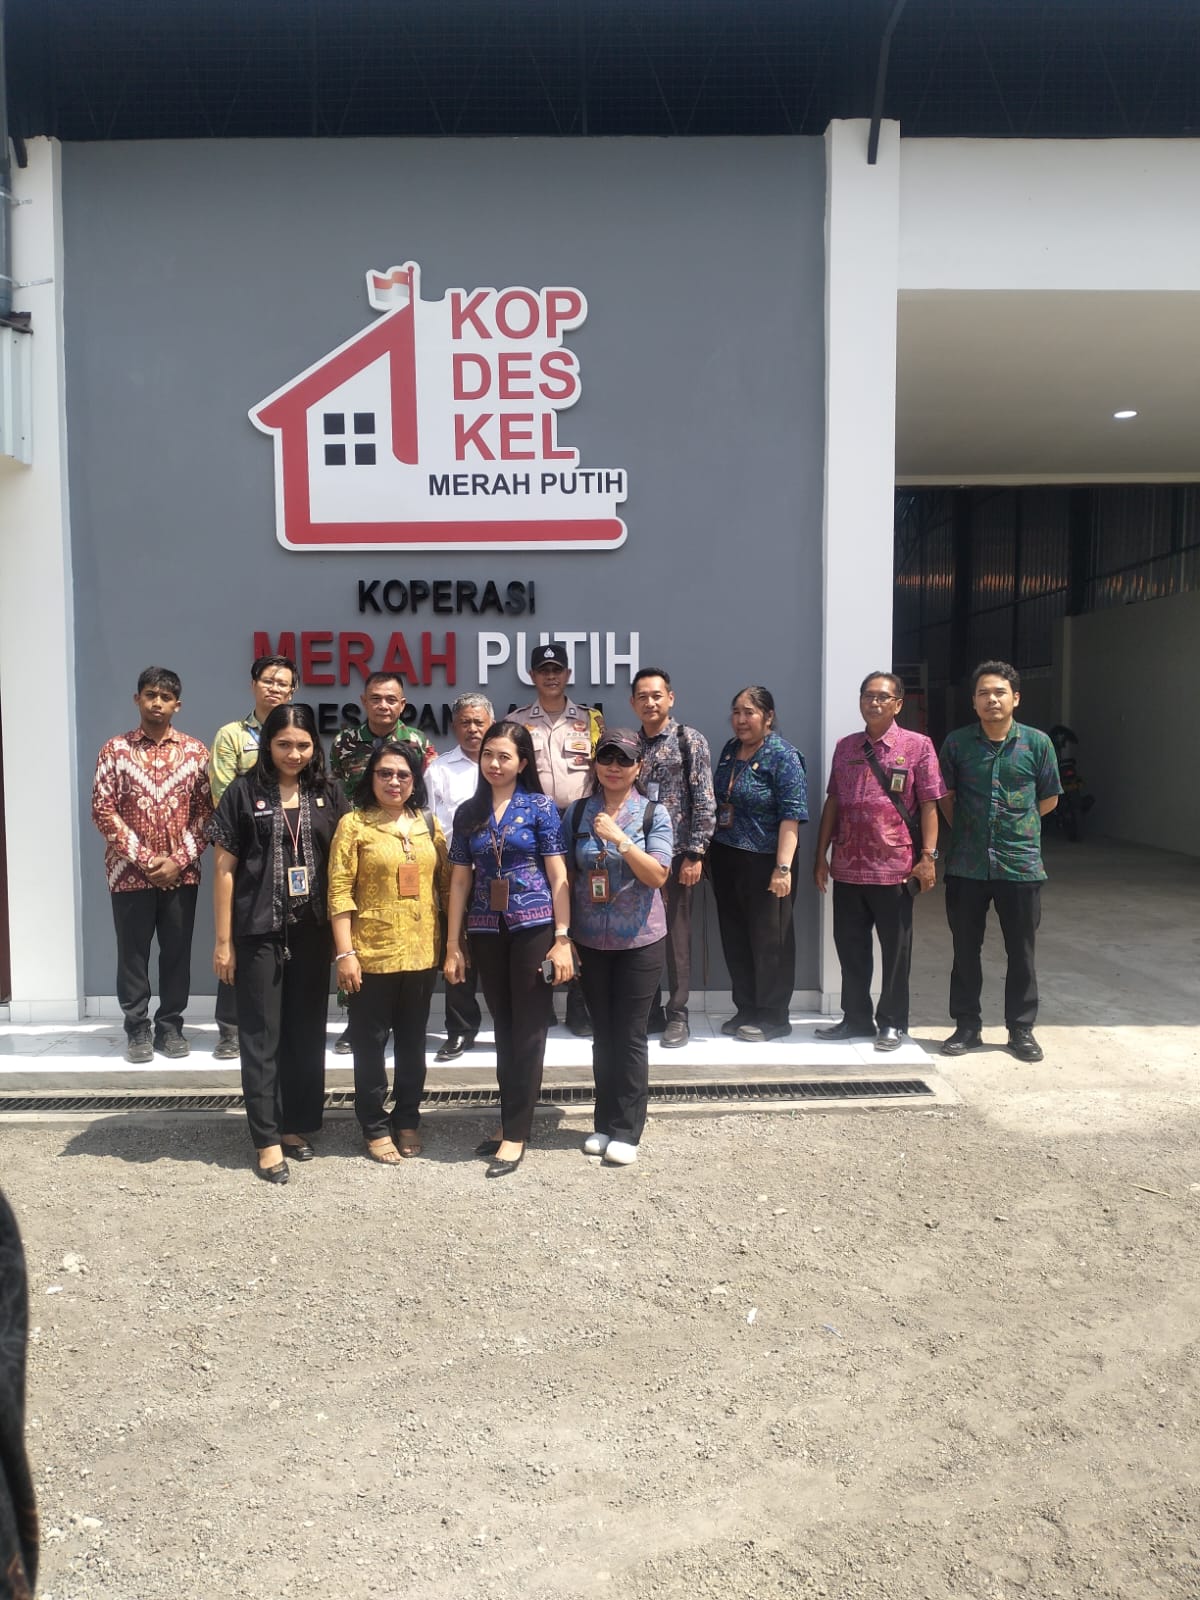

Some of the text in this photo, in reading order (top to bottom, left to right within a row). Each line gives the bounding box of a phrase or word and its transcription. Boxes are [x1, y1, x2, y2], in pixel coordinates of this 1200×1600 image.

[451, 290, 582, 340] KOP
[453, 351, 576, 400] DES
[454, 413, 575, 460] KEL
[428, 472, 623, 495] MERAH PUTIH
[358, 580, 535, 614] KOPERASI
[478, 631, 640, 686] PUTIH
